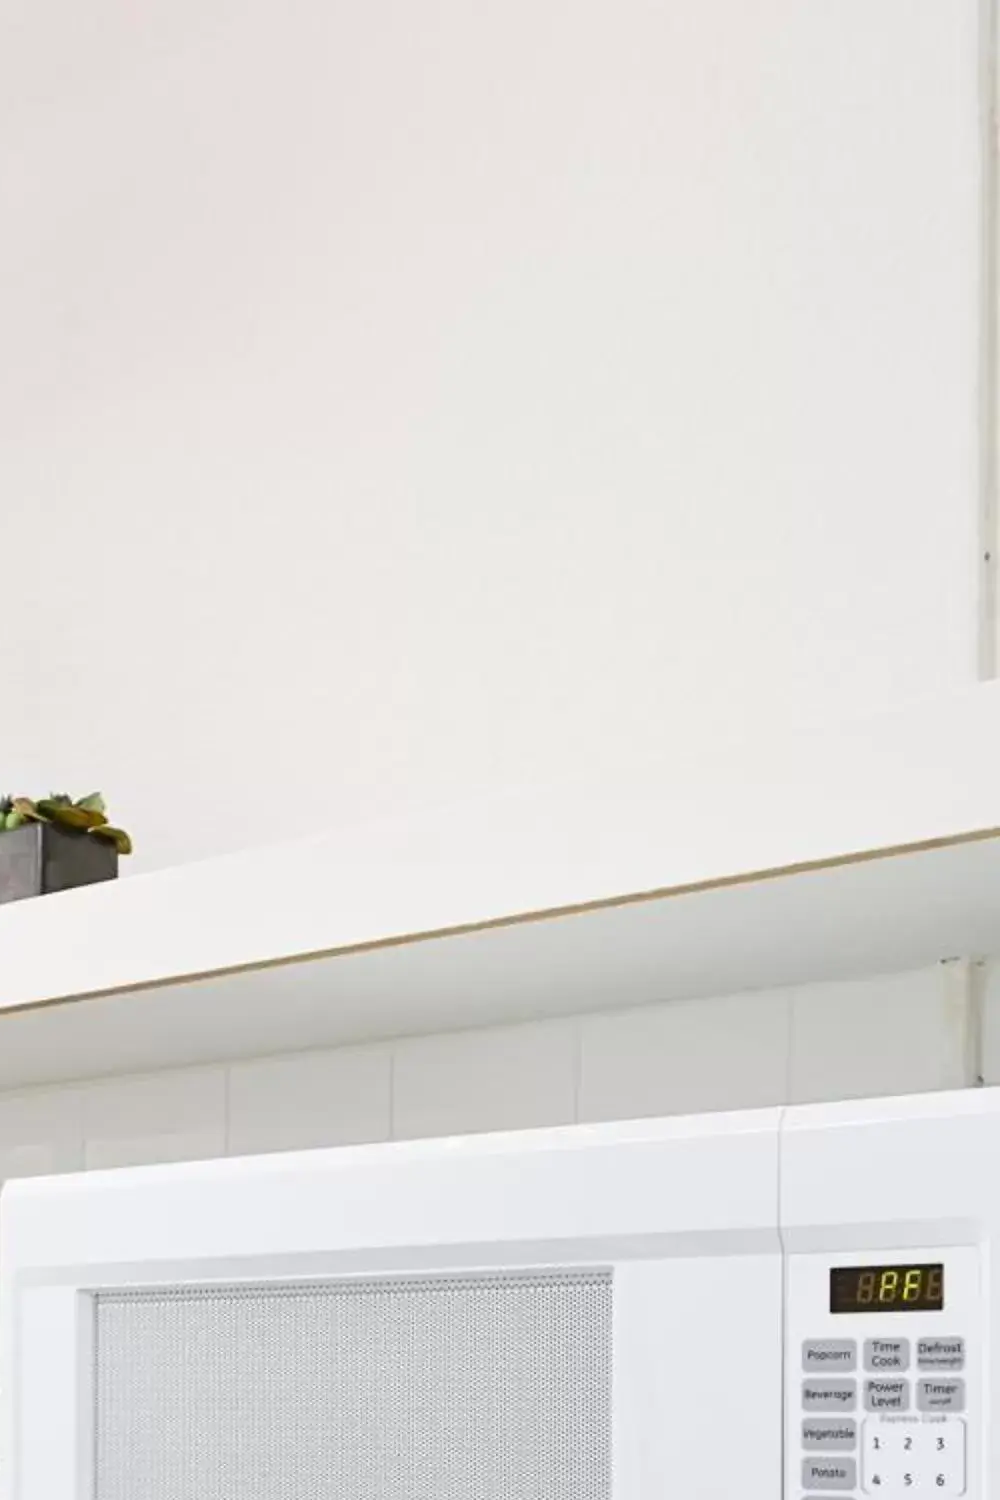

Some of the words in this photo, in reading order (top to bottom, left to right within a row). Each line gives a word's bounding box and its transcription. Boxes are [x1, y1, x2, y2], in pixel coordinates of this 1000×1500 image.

[879, 1270, 921, 1301] PF
[872, 1341, 901, 1352] Time
[918, 1342, 962, 1354] Defrost
[807, 1349, 851, 1361] Popcorn
[871, 1355, 901, 1367] Cook
[868, 1381, 904, 1393] Power
[923, 1383, 958, 1394] Timer
[804, 1389, 853, 1401] Beverage
[871, 1395, 901, 1407] Level
[803, 1428, 855, 1440] Vegetable
[873, 1437, 881, 1450] 1
[904, 1437, 912, 1450] 2
[936, 1437, 945, 1451] 3
[811, 1467, 846, 1478] Potato
[872, 1474, 881, 1485] 4
[904, 1473, 912, 1486] 5
[936, 1473, 945, 1487] 6
